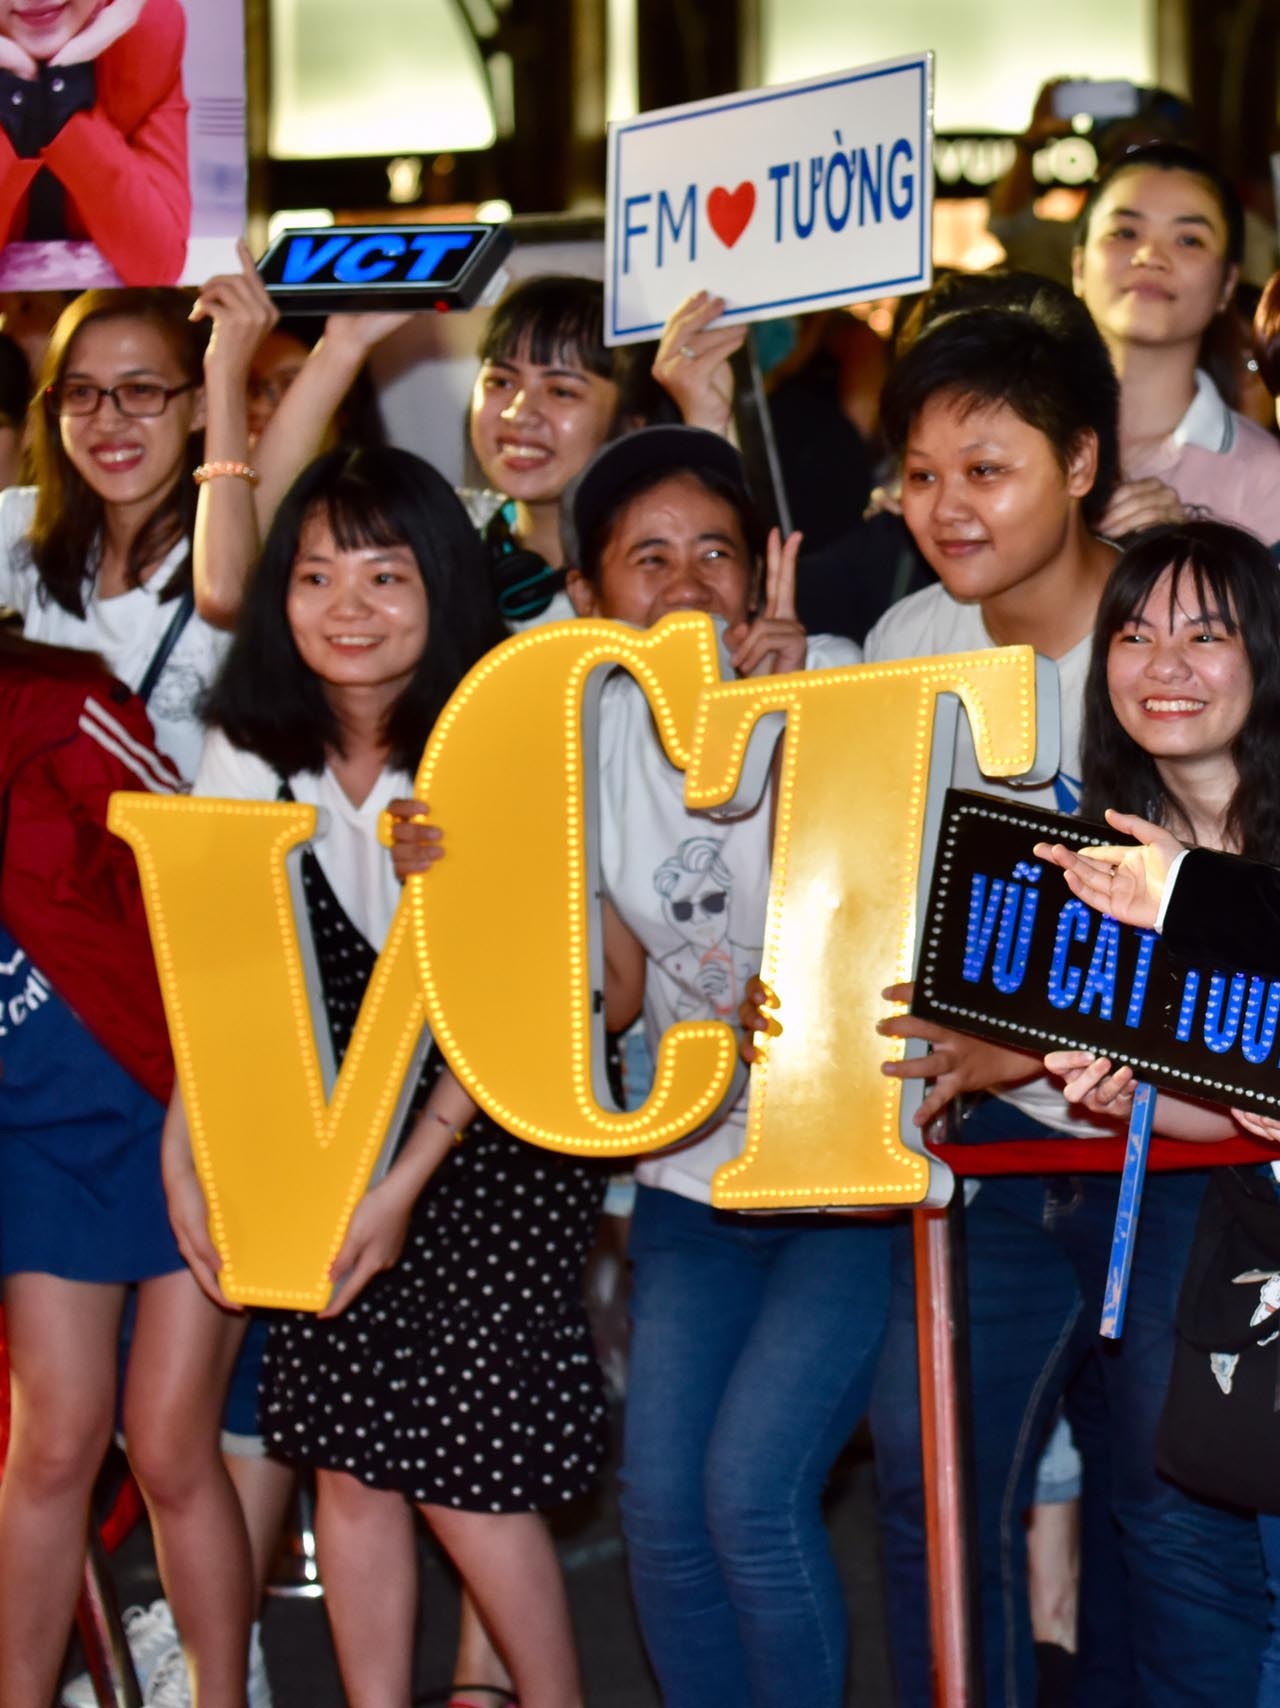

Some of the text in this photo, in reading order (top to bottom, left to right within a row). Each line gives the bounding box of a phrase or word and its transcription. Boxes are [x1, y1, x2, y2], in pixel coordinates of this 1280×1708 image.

[281, 233, 475, 284] VCT
[623, 183, 697, 275] FM
[107, 611, 1037, 1312] VCT
